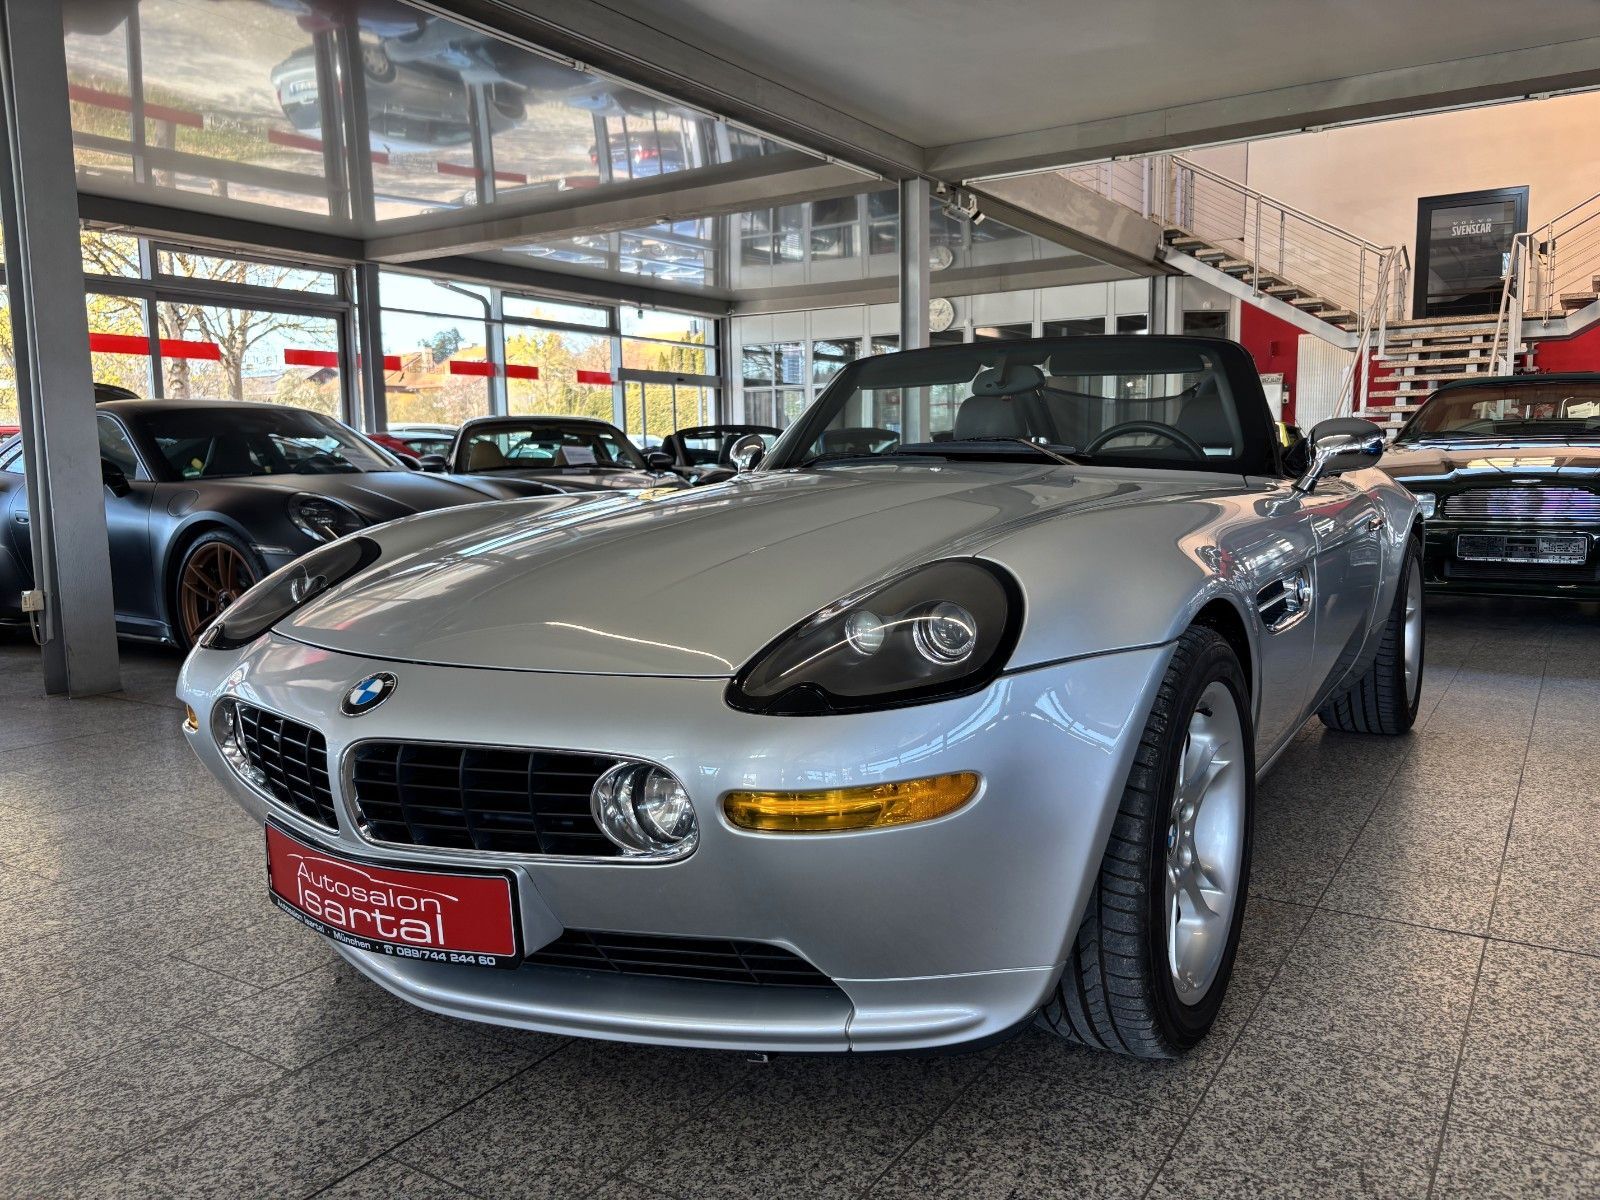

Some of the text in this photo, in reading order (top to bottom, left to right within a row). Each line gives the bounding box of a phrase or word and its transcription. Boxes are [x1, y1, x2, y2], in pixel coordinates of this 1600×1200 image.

[1451, 223, 1492, 236] SVENSCAR
[297, 862, 441, 914] Autosalon
[297, 876, 445, 945] Isartal
[303, 915, 325, 933] Isartal
[333, 931, 371, 950] München
[396, 947, 447, 962] 089/744
[450, 954, 476, 965] 244
[478, 955, 496, 967] 60
